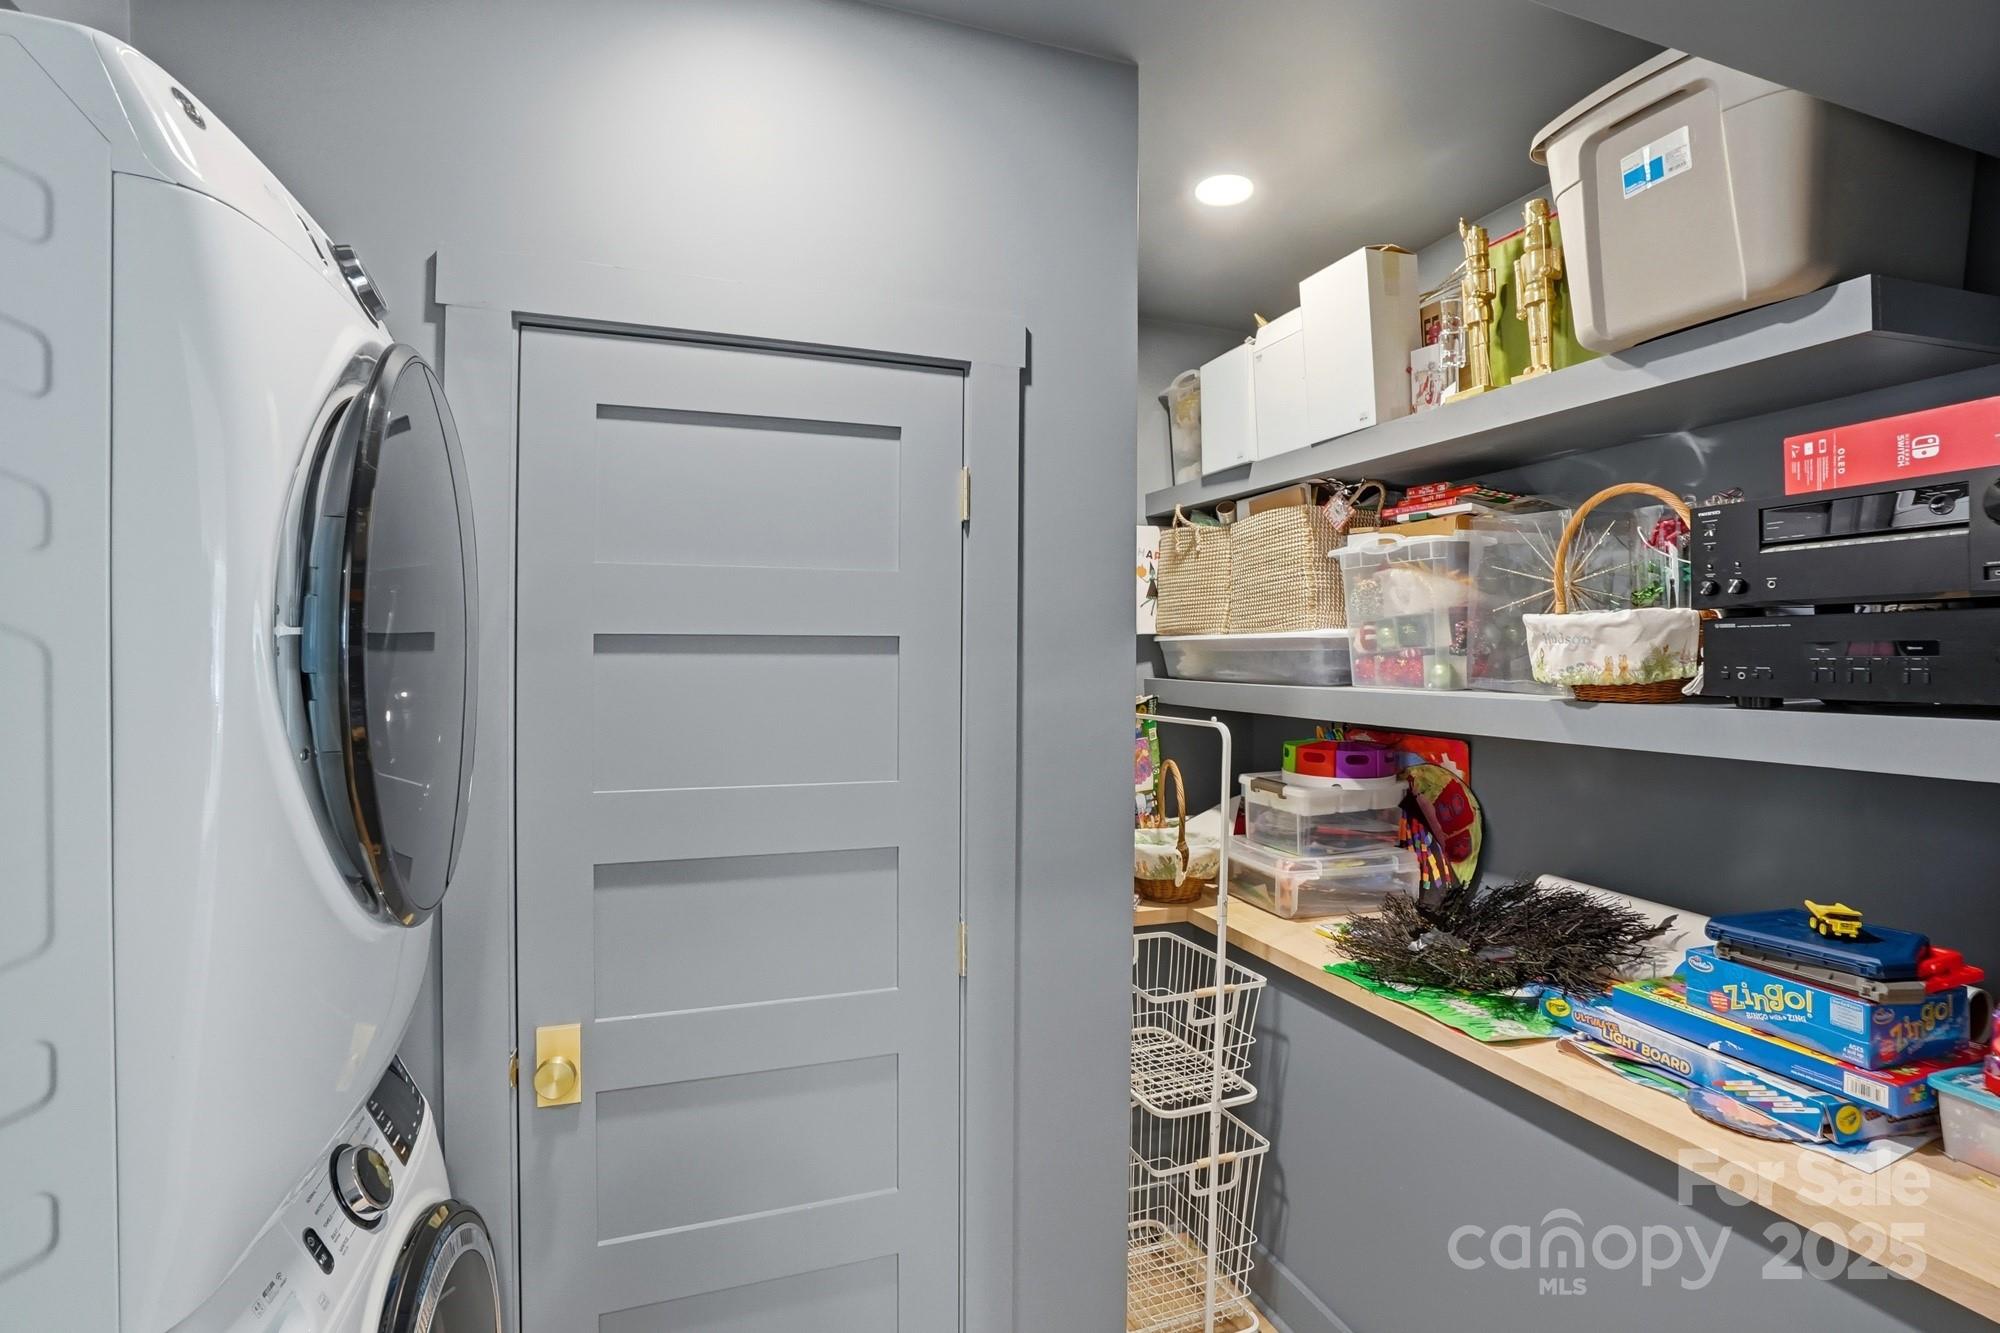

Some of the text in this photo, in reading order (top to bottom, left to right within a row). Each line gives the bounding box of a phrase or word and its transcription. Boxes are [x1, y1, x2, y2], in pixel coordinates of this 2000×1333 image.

[1837, 448, 1846, 474] OLED
[1897, 434, 1905, 467] SWITCH
[1723, 981, 1813, 1019] Zingo!
[1574, 1011, 1620, 1033] ULTIMATE
[1602, 1028, 1692, 1076] LIGHT BOARD
